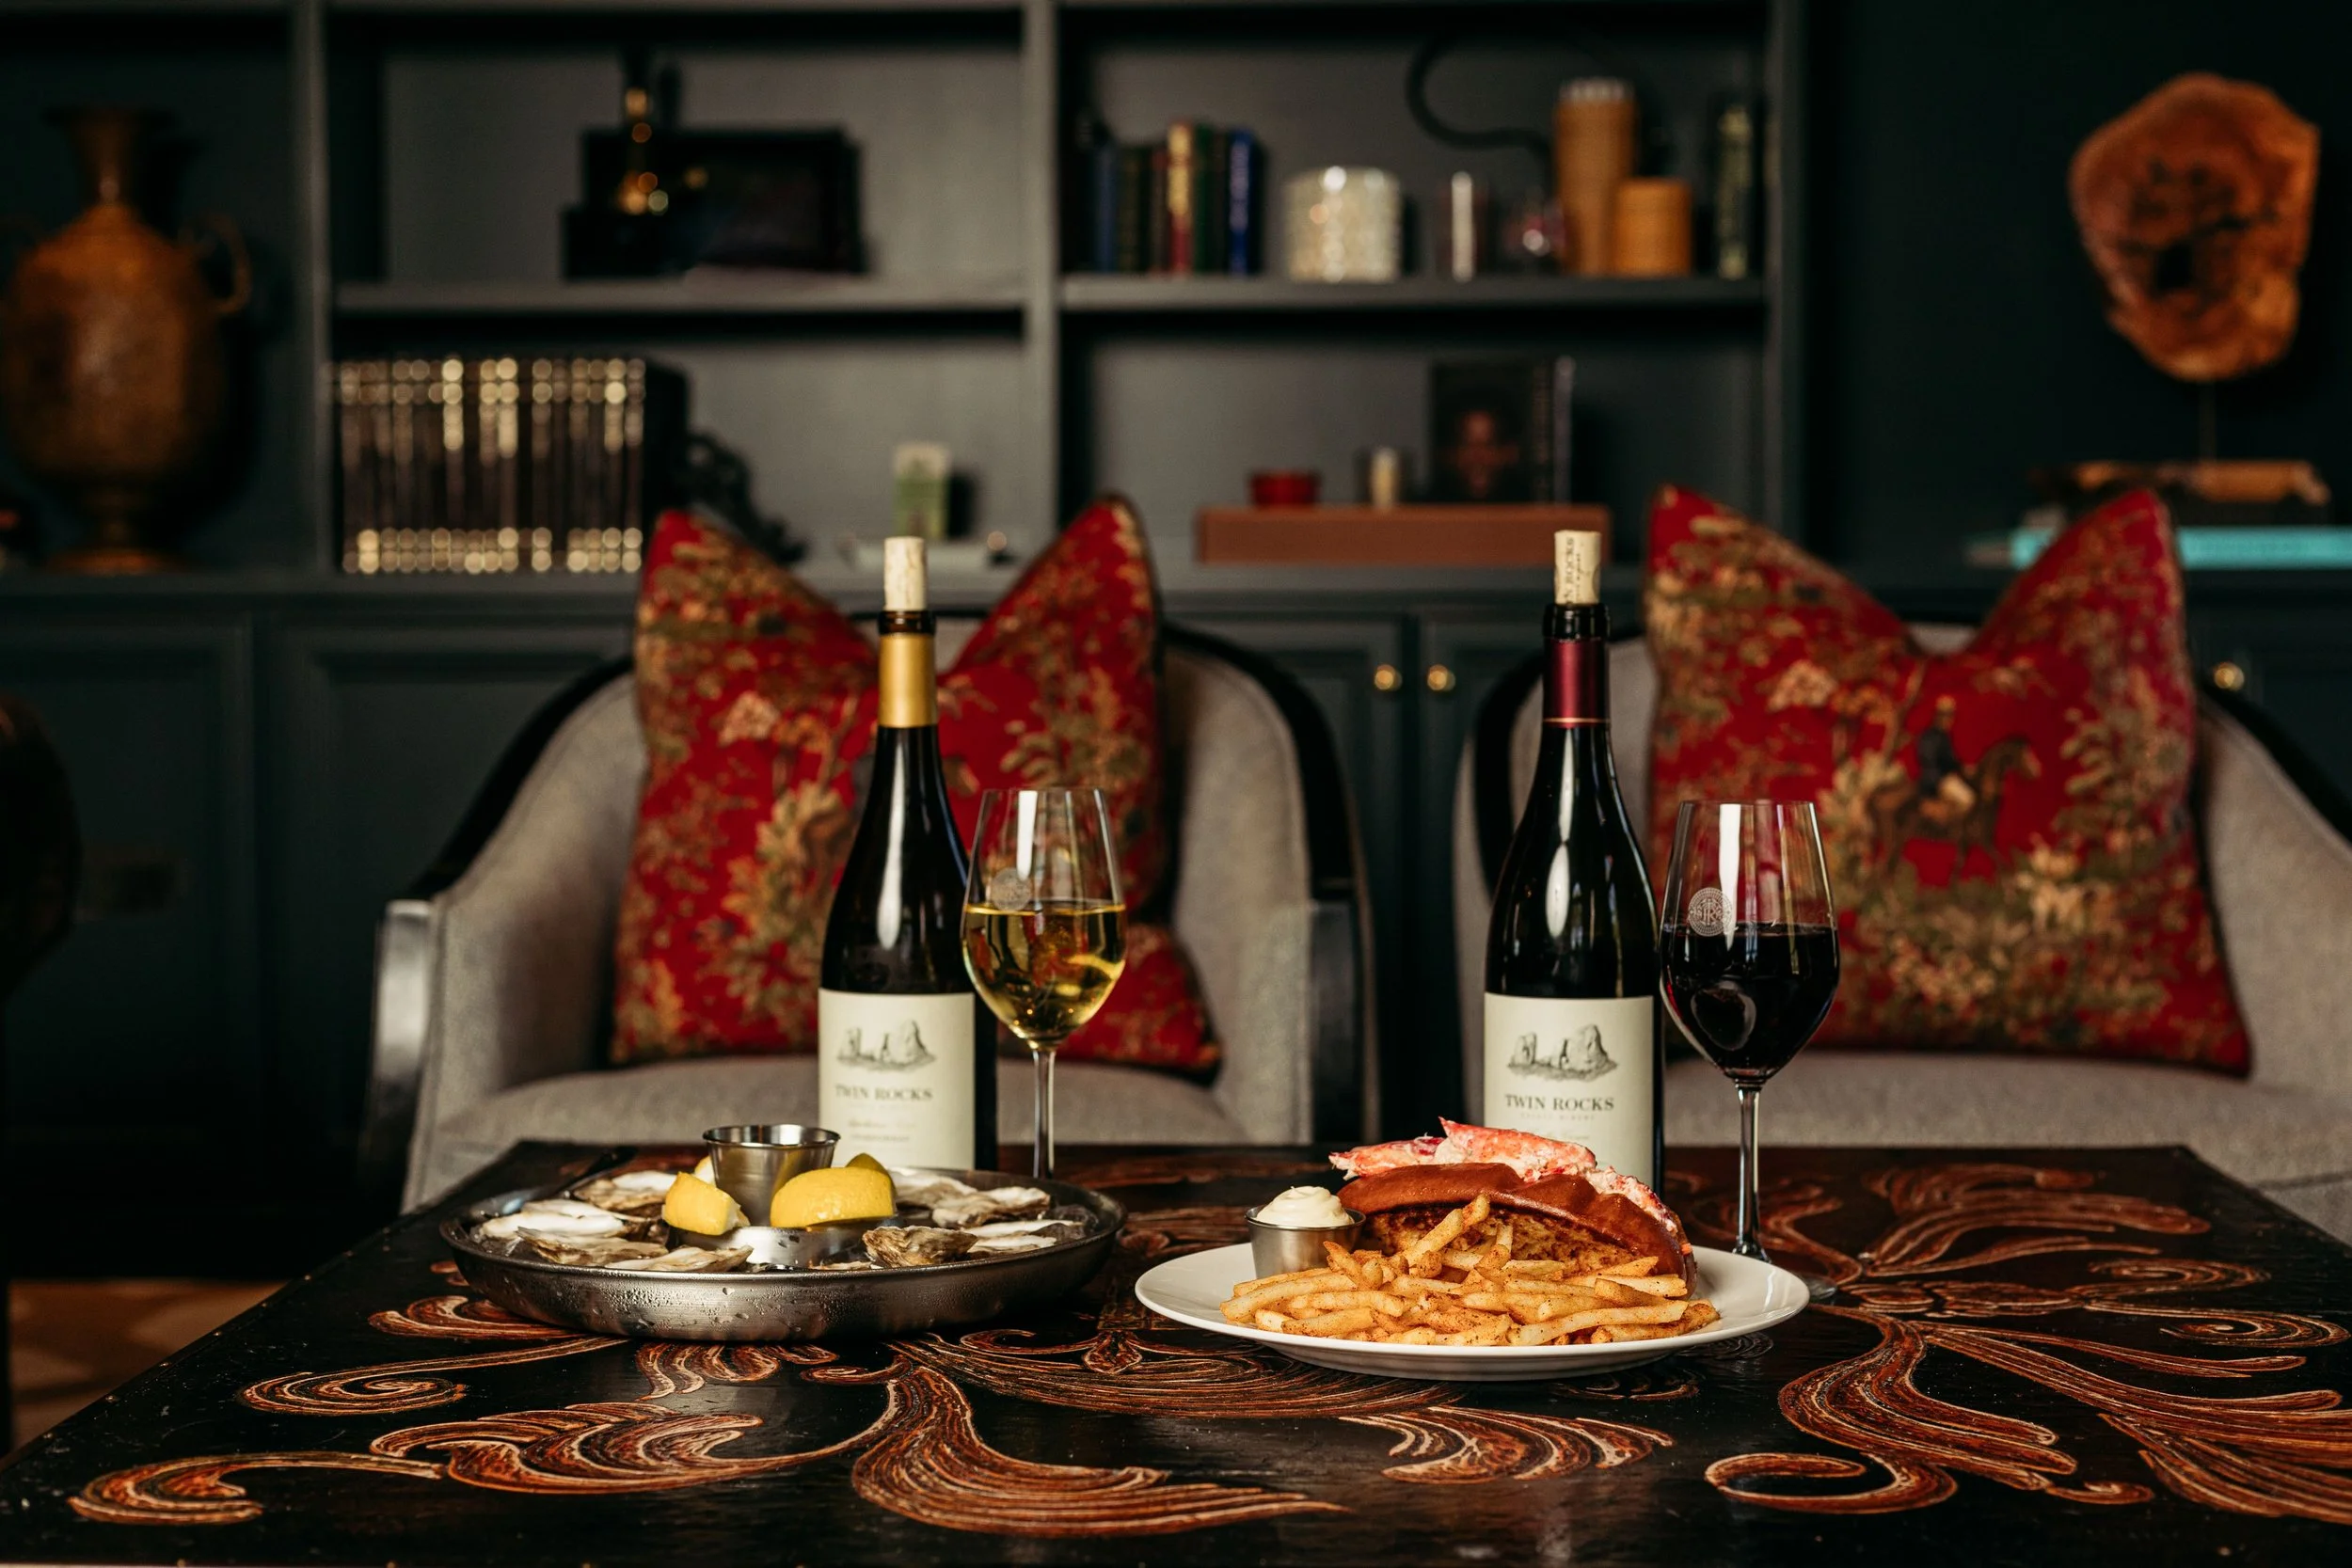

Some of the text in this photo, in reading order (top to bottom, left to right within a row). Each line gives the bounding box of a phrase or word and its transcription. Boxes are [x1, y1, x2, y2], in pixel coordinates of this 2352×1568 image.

[835, 1085, 933, 1101] TWIN ROCKS
[1504, 1094, 1614, 1111] TWIN ROCKS
